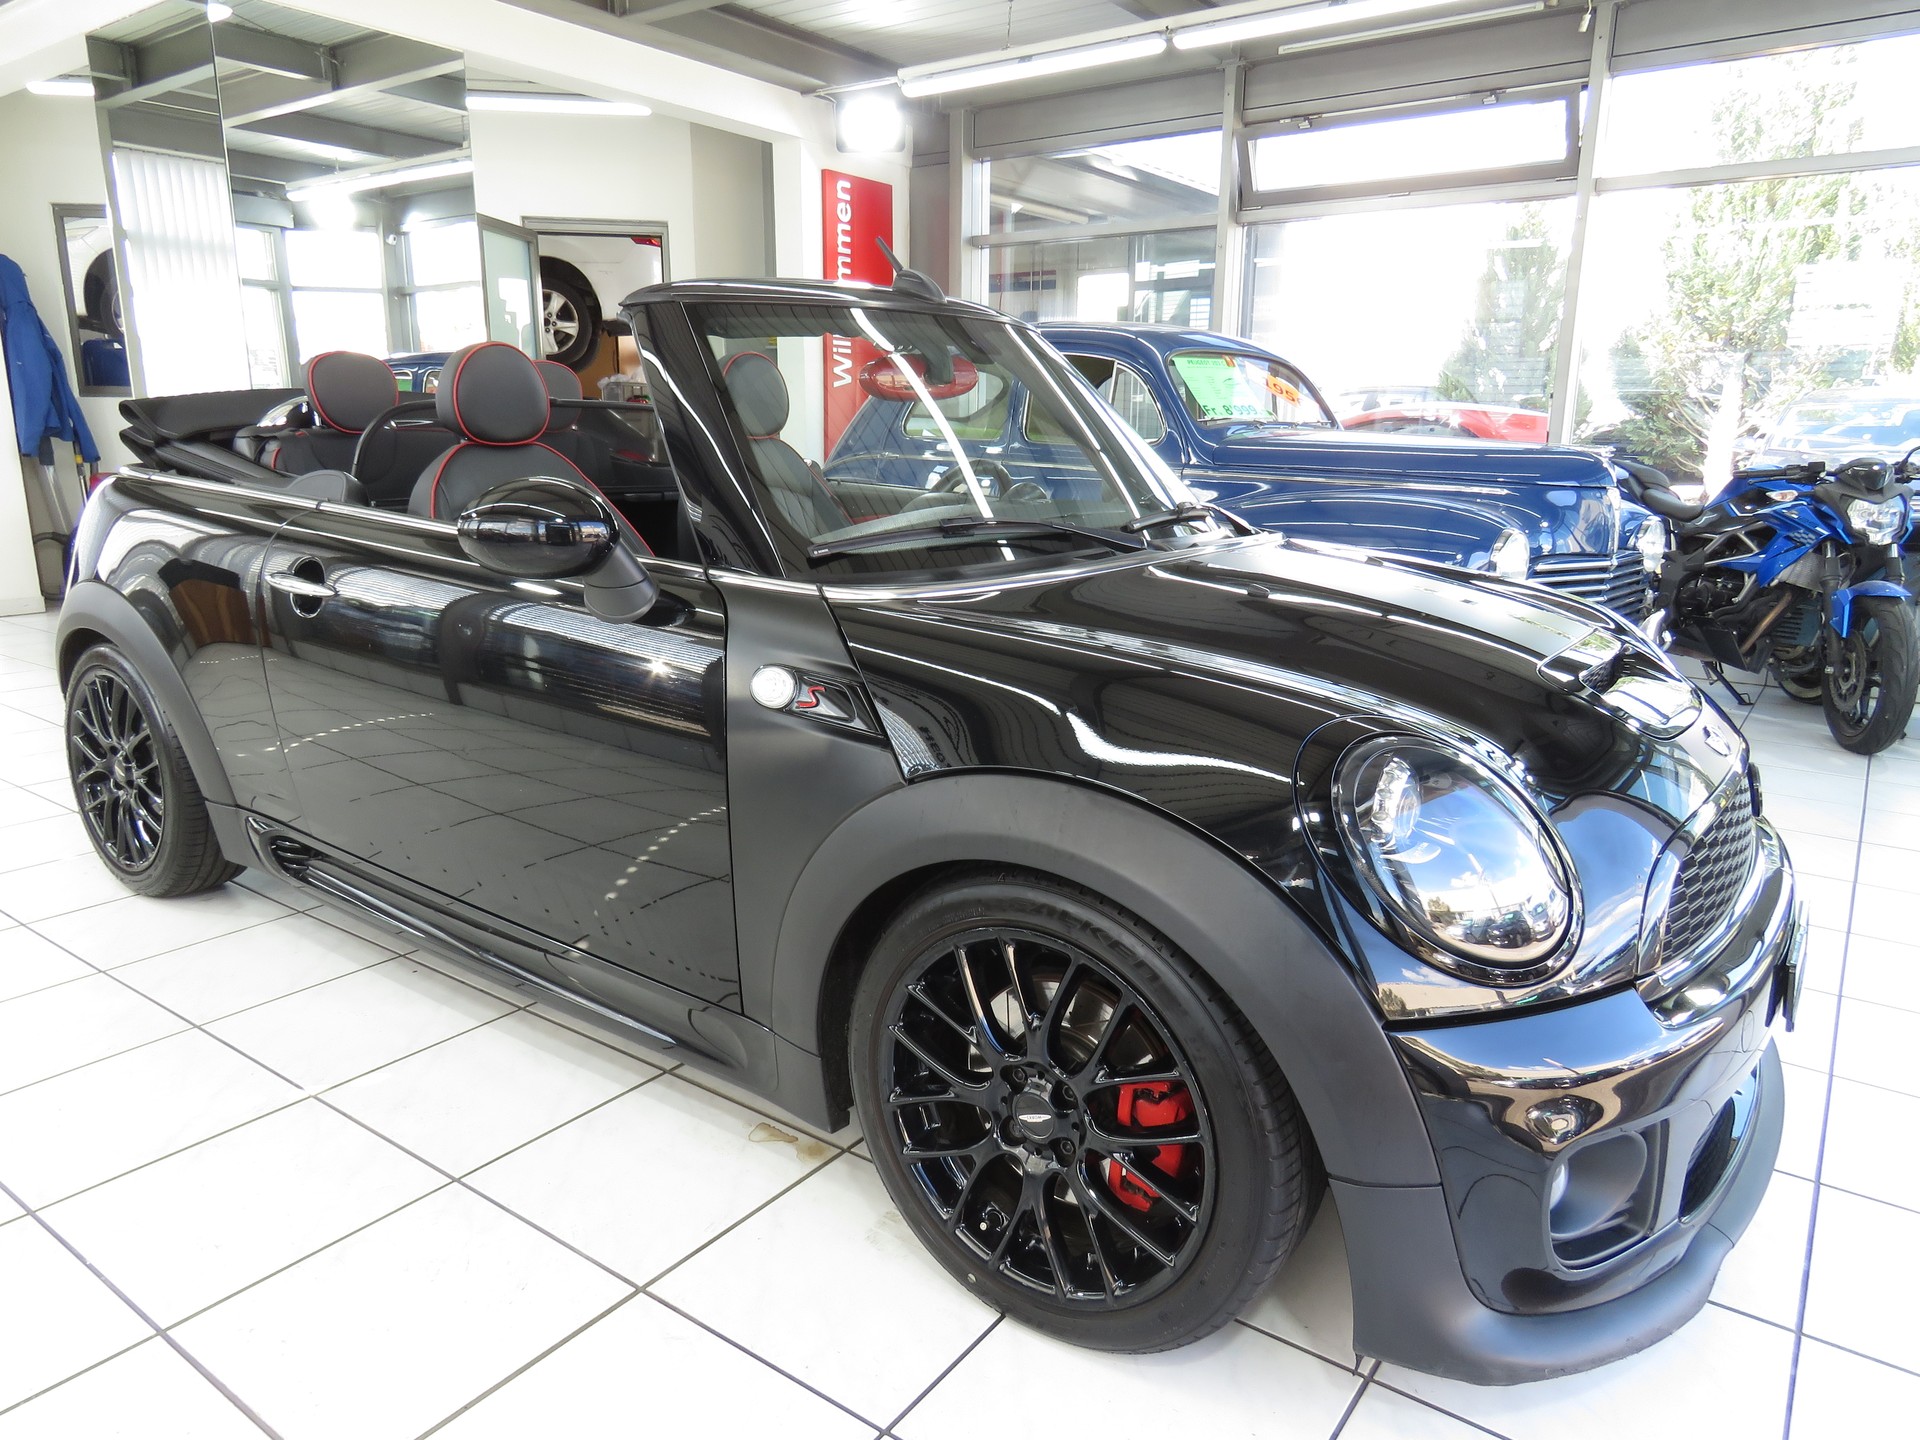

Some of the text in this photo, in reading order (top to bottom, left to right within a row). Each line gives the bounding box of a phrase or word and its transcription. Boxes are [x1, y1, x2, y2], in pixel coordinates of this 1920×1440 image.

[832, 179, 853, 388] Wilmmen
[1203, 404, 1222, 416] Fr.
[796, 686, 826, 709] S
